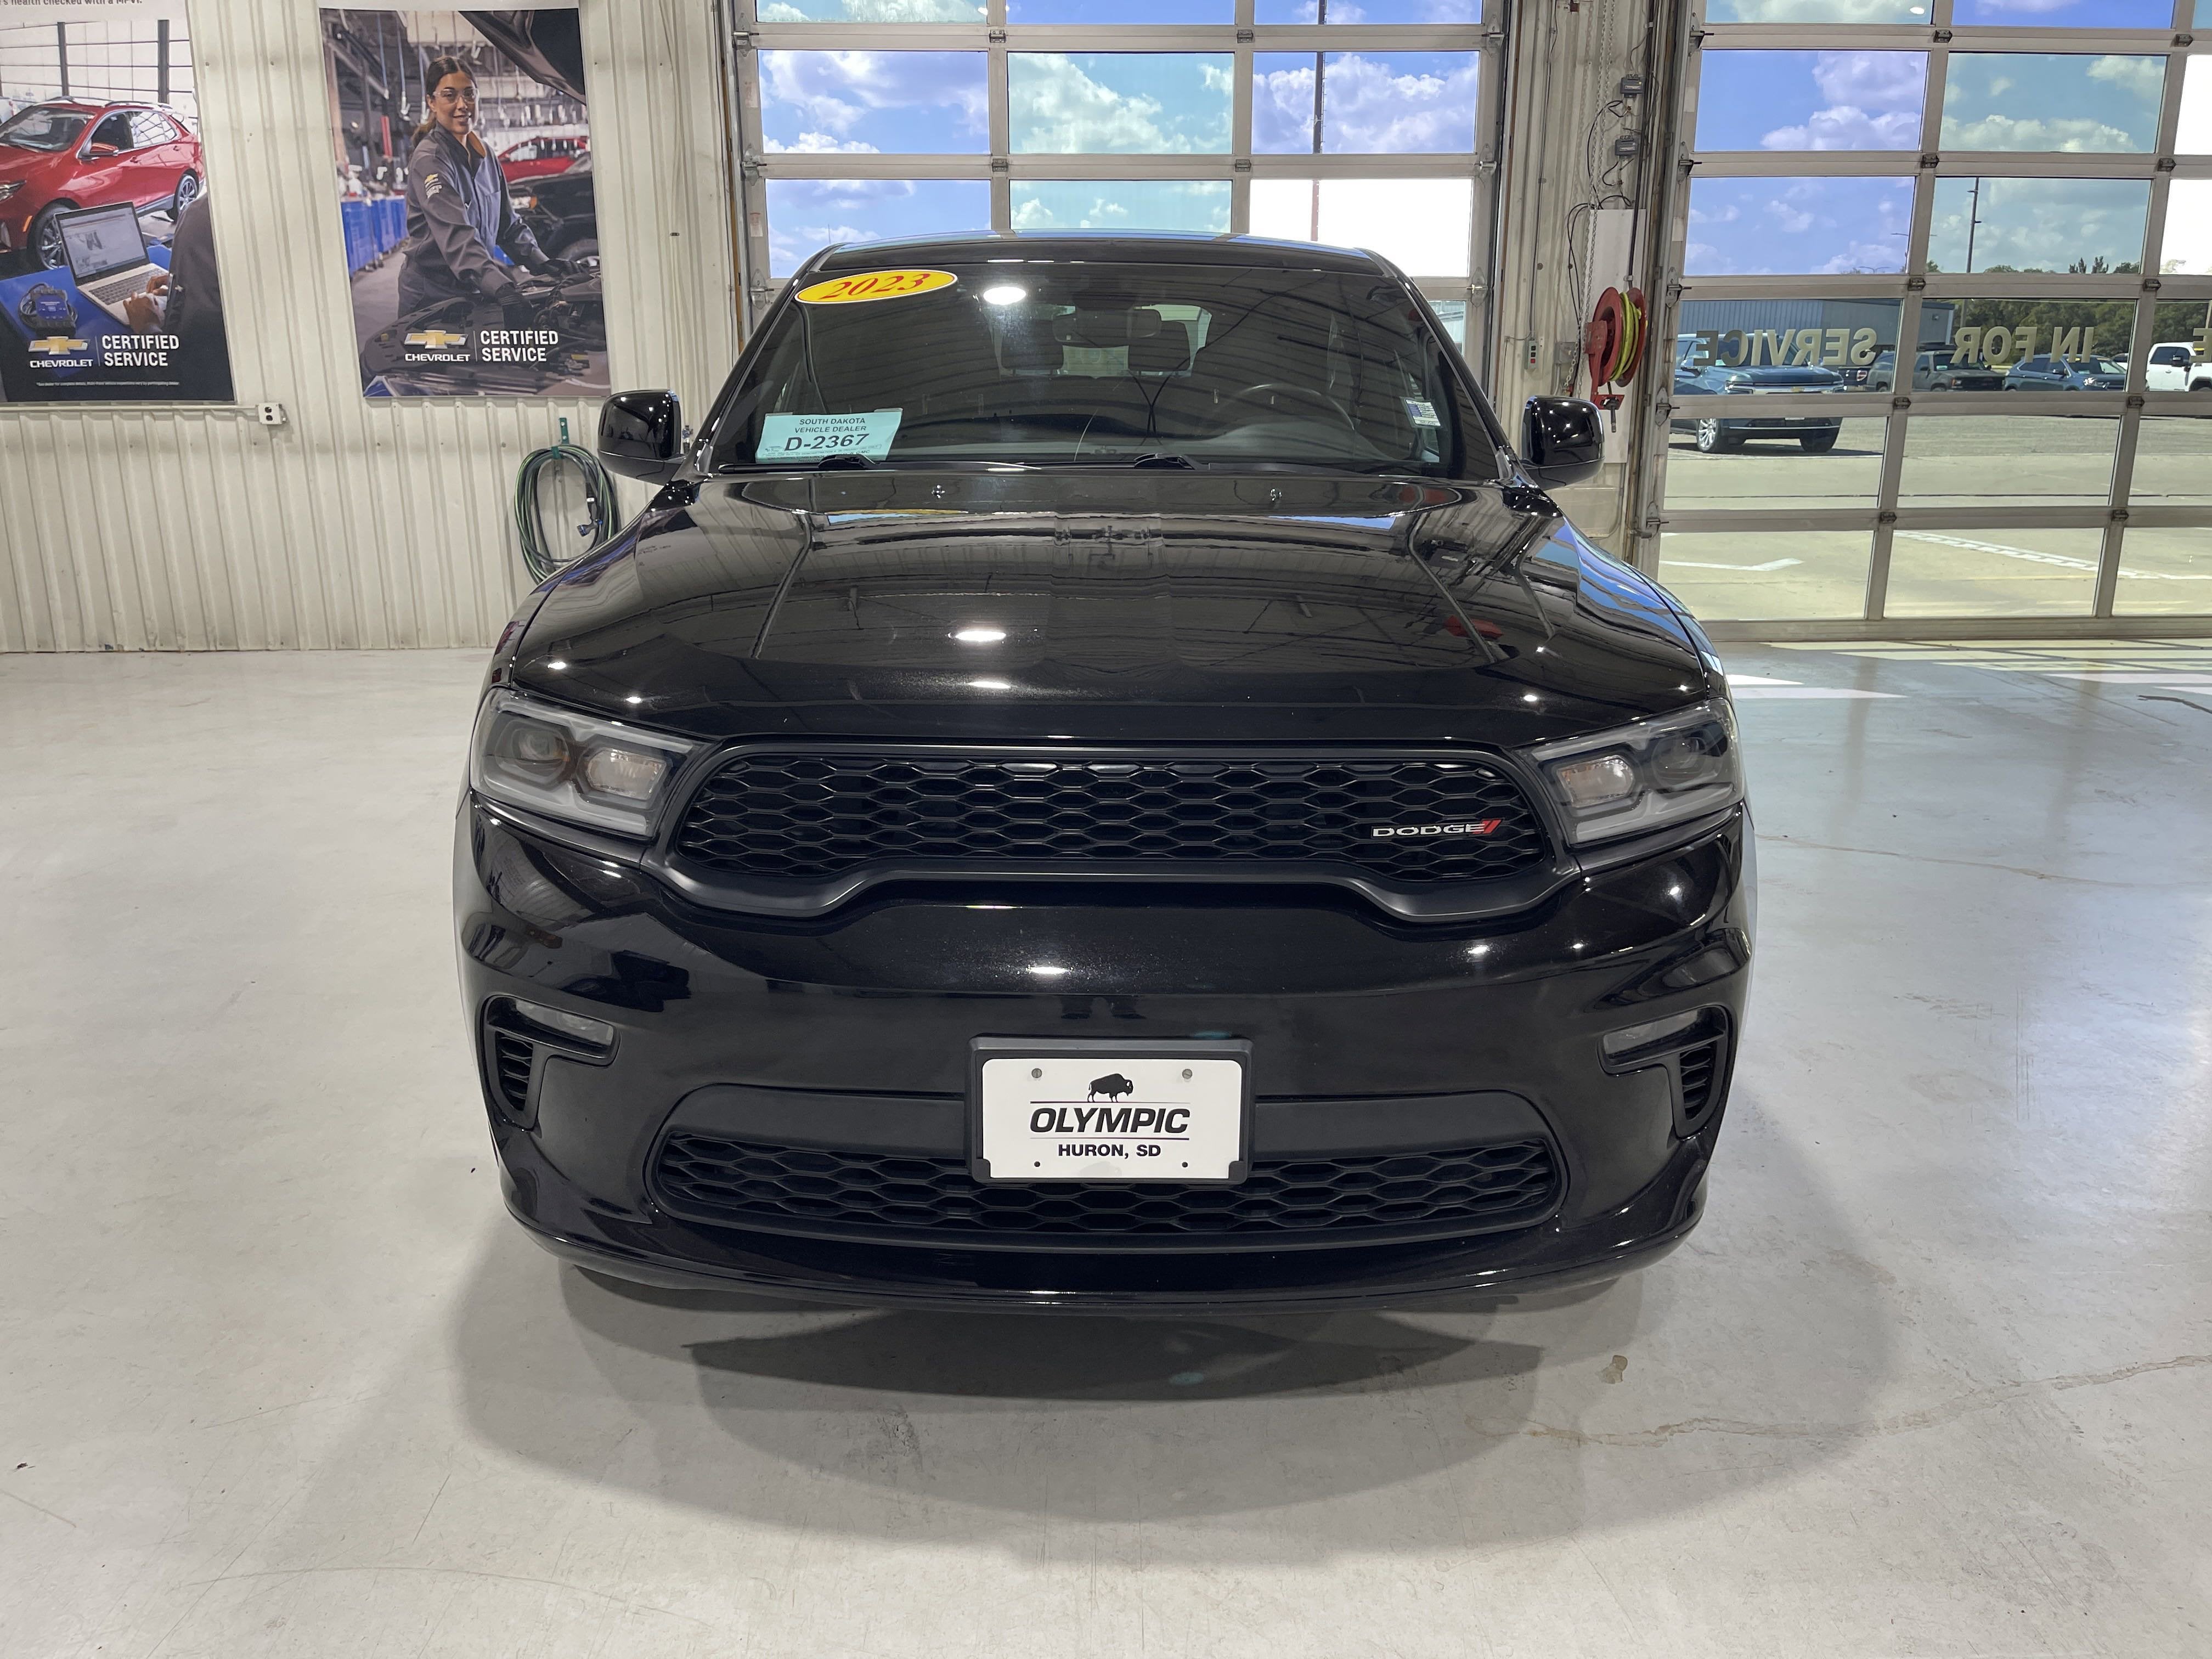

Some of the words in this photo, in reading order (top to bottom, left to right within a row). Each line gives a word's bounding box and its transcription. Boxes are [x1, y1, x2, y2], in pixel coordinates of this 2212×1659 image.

[818, 273, 931, 300] 2023
[101, 334, 179, 349] CERTIFIED
[479, 330, 559, 345] CERTIFIED
[104, 351, 168, 367] SERVICE
[405, 353, 471, 362] CHEVROLET
[482, 347, 547, 362] SERVICE
[30, 358, 93, 368] CHEVROLET
[784, 433, 870, 452] D-2367
[1373, 823, 1485, 837] DODGE
[1030, 1107, 1190, 1133] OLYMPIC
[1058, 1144, 1129, 1159] HURON,
[1136, 1144, 1161, 1157] SD
